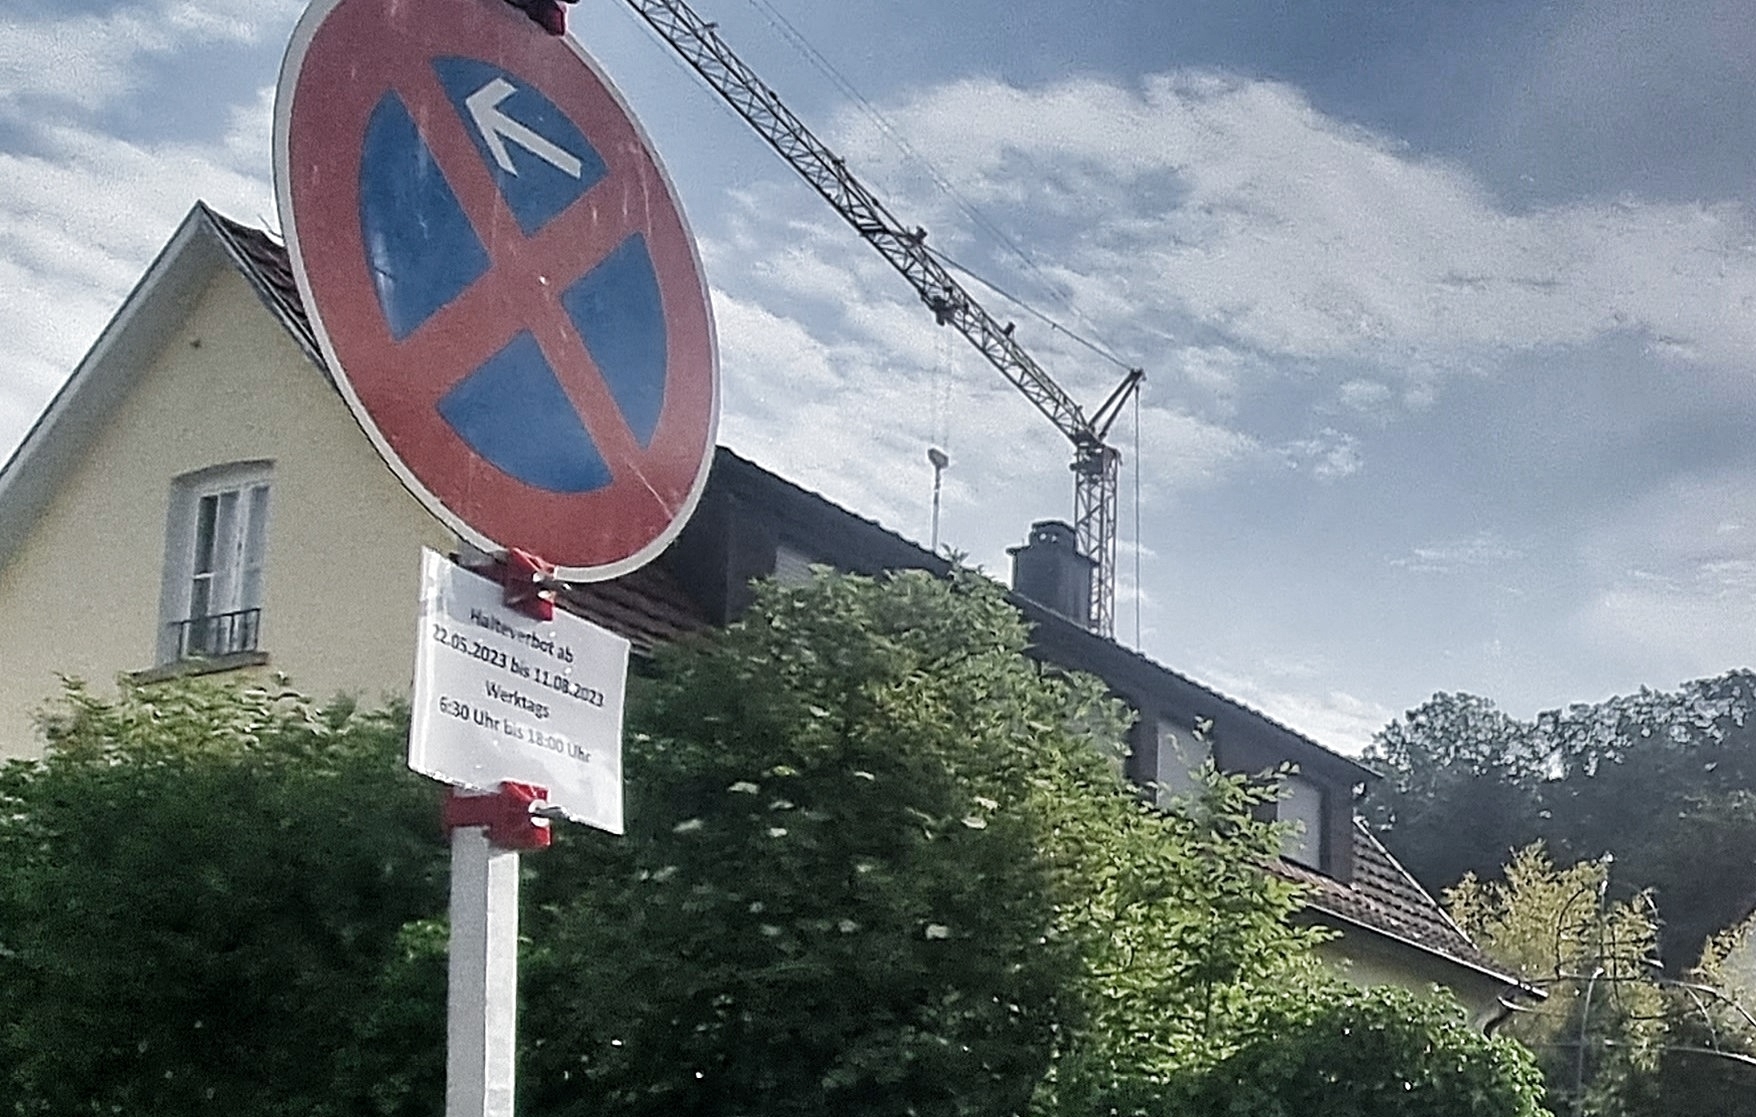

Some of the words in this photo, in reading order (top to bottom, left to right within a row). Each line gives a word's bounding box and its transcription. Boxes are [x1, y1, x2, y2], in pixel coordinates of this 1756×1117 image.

[433, 624, 507, 668] 22.05.2023
[511, 656, 530, 678] bis
[534, 667, 604, 708] 11.08.2023
[470, 608, 555, 656] Halteverbot
[557, 645, 574, 663] ab
[439, 696, 469, 721] 6:30
[473, 711, 500, 731] Uhr
[504, 718, 524, 740] bis
[528, 729, 564, 753] 18:00
[567, 742, 591, 763] Uhr
[485, 680, 550, 719] Werktags
